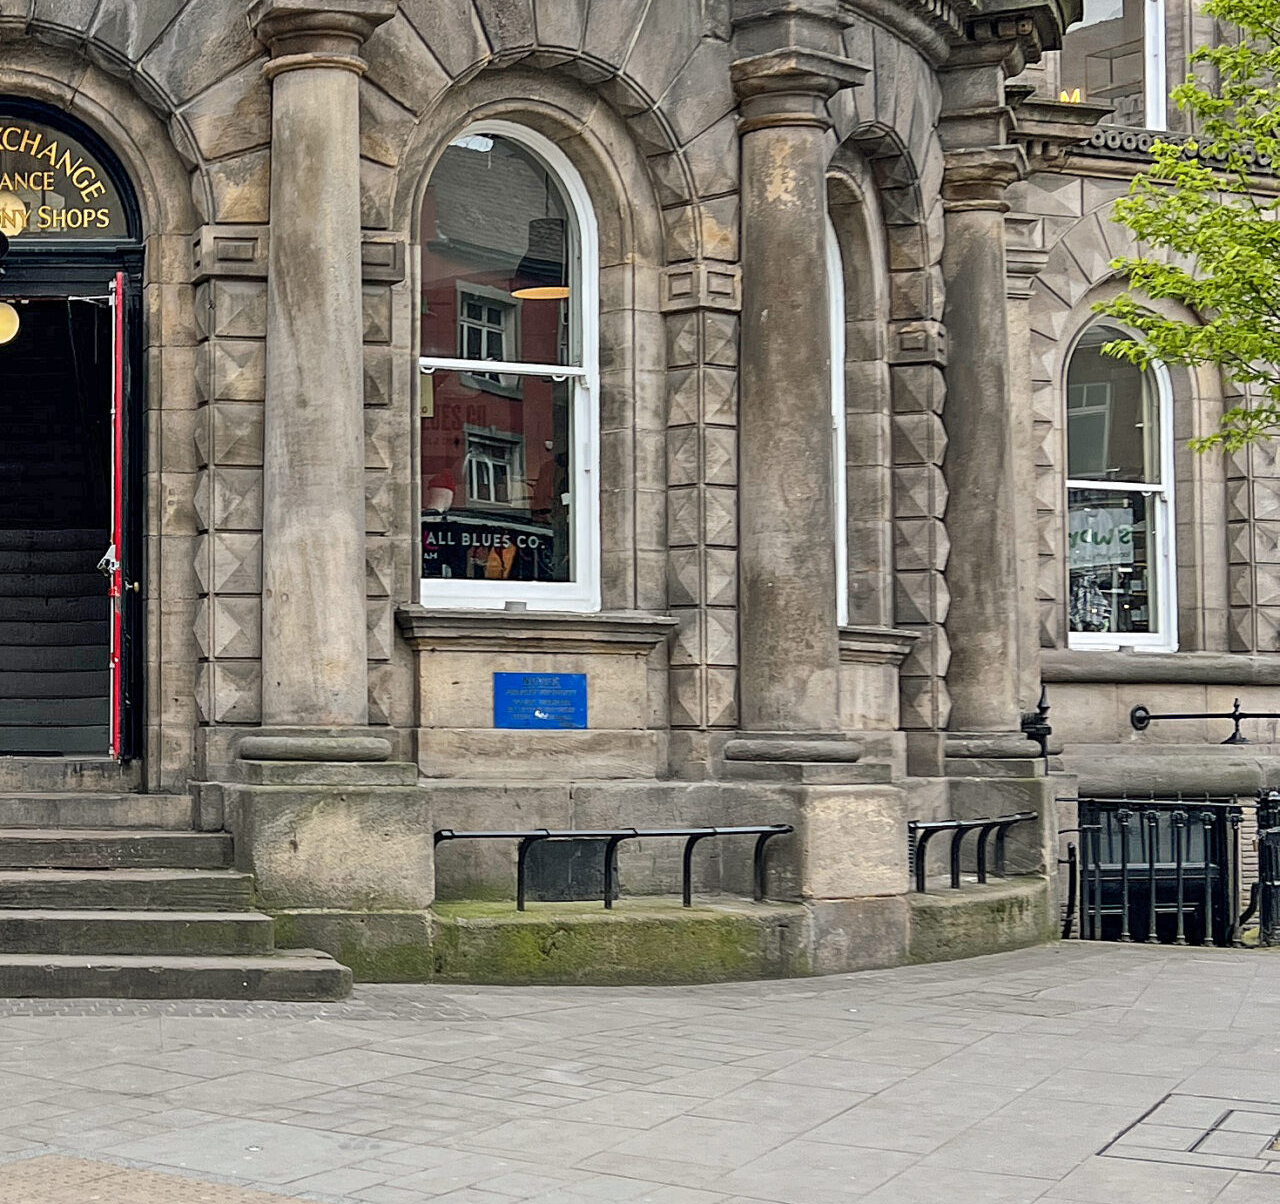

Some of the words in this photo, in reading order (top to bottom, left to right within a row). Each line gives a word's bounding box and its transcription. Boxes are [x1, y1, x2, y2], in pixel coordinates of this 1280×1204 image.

[37, 206, 111, 229] SHOPS
[426, 532, 455, 545] ALL
[461, 533, 511, 548] BLUES
[516, 535, 545, 549] CO.
